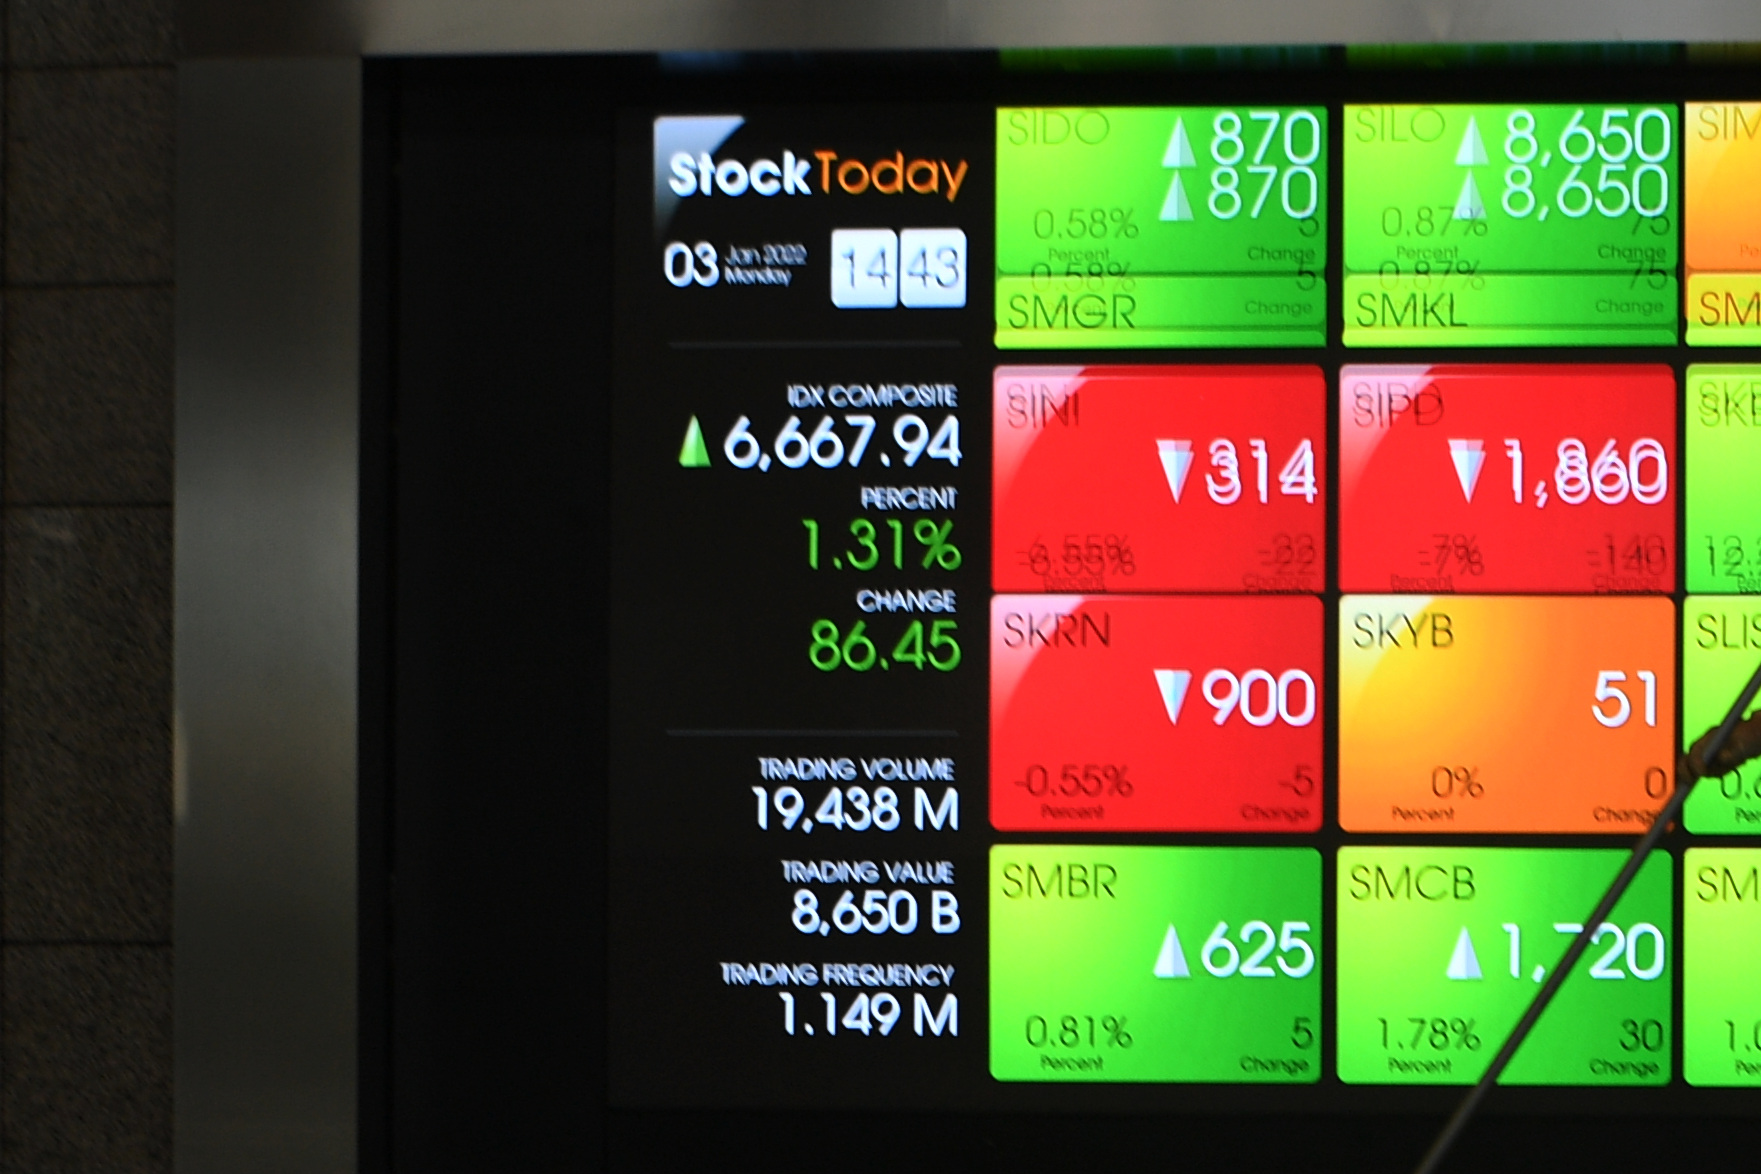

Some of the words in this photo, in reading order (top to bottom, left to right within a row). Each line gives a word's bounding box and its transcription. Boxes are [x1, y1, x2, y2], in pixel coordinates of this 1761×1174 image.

[1008, 110, 1110, 145] SIDO
[1210, 110, 1320, 166] 870
[1355, 107, 1446, 143] SILO
[1504, 108, 1671, 168] 8,650
[1207, 165, 1318, 220] 870
[1501, 163, 1668, 222] 8,650
[1033, 207, 1139, 239] 0.58%
[664, 241, 719, 287] 03
[724, 246, 761, 265] Jan
[842, 246, 891, 290] 14
[907, 246, 960, 290] 43
[1247, 246, 1315, 264] Change
[1597, 244, 1667, 263] Change
[724, 266, 792, 287] Monday
[1008, 293, 1137, 330] SMGR
[1355, 292, 1468, 328] SMKL
[788, 385, 824, 407] IDX
[827, 385, 958, 407] COMPOSITE
[723, 415, 962, 472] 6,667.94
[1206, 437, 1318, 505] 314
[1503, 437, 1668, 508] 1,860
[861, 487, 958, 510] PERCENT
[802, 518, 962, 570] 1.31%
[857, 590, 957, 613] CHANGE
[809, 619, 961, 671] 86.45
[1002, 612, 1111, 648] SKRN
[1352, 613, 1454, 648] SKYB
[1202, 669, 1317, 727] 900
[1592, 670, 1657, 728] 51
[758, 757, 857, 781] TRADING
[860, 757, 955, 781] VOLUME
[1013, 765, 1133, 799] -0.55%
[1432, 766, 1484, 799] 0%
[752, 786, 900, 834] 19,438
[914, 786, 958, 831] M
[781, 860, 879, 883] TRADING
[883, 860, 955, 883] VALUE
[1001, 864, 1117, 901] SMBR
[1349, 865, 1475, 901] SMCB
[791, 889, 918, 937] 8,650
[931, 890, 961, 934] B
[1200, 921, 1314, 980] 625
[720, 962, 819, 986] TRADING
[822, 963, 955, 986] FREQUENCY
[779, 991, 900, 1036] 1.149
[914, 992, 958, 1036] M
[1025, 1016, 1133, 1049] 0.81%
[1378, 1018, 1481, 1051] 1.78%
[1620, 1019, 1663, 1052] 30
